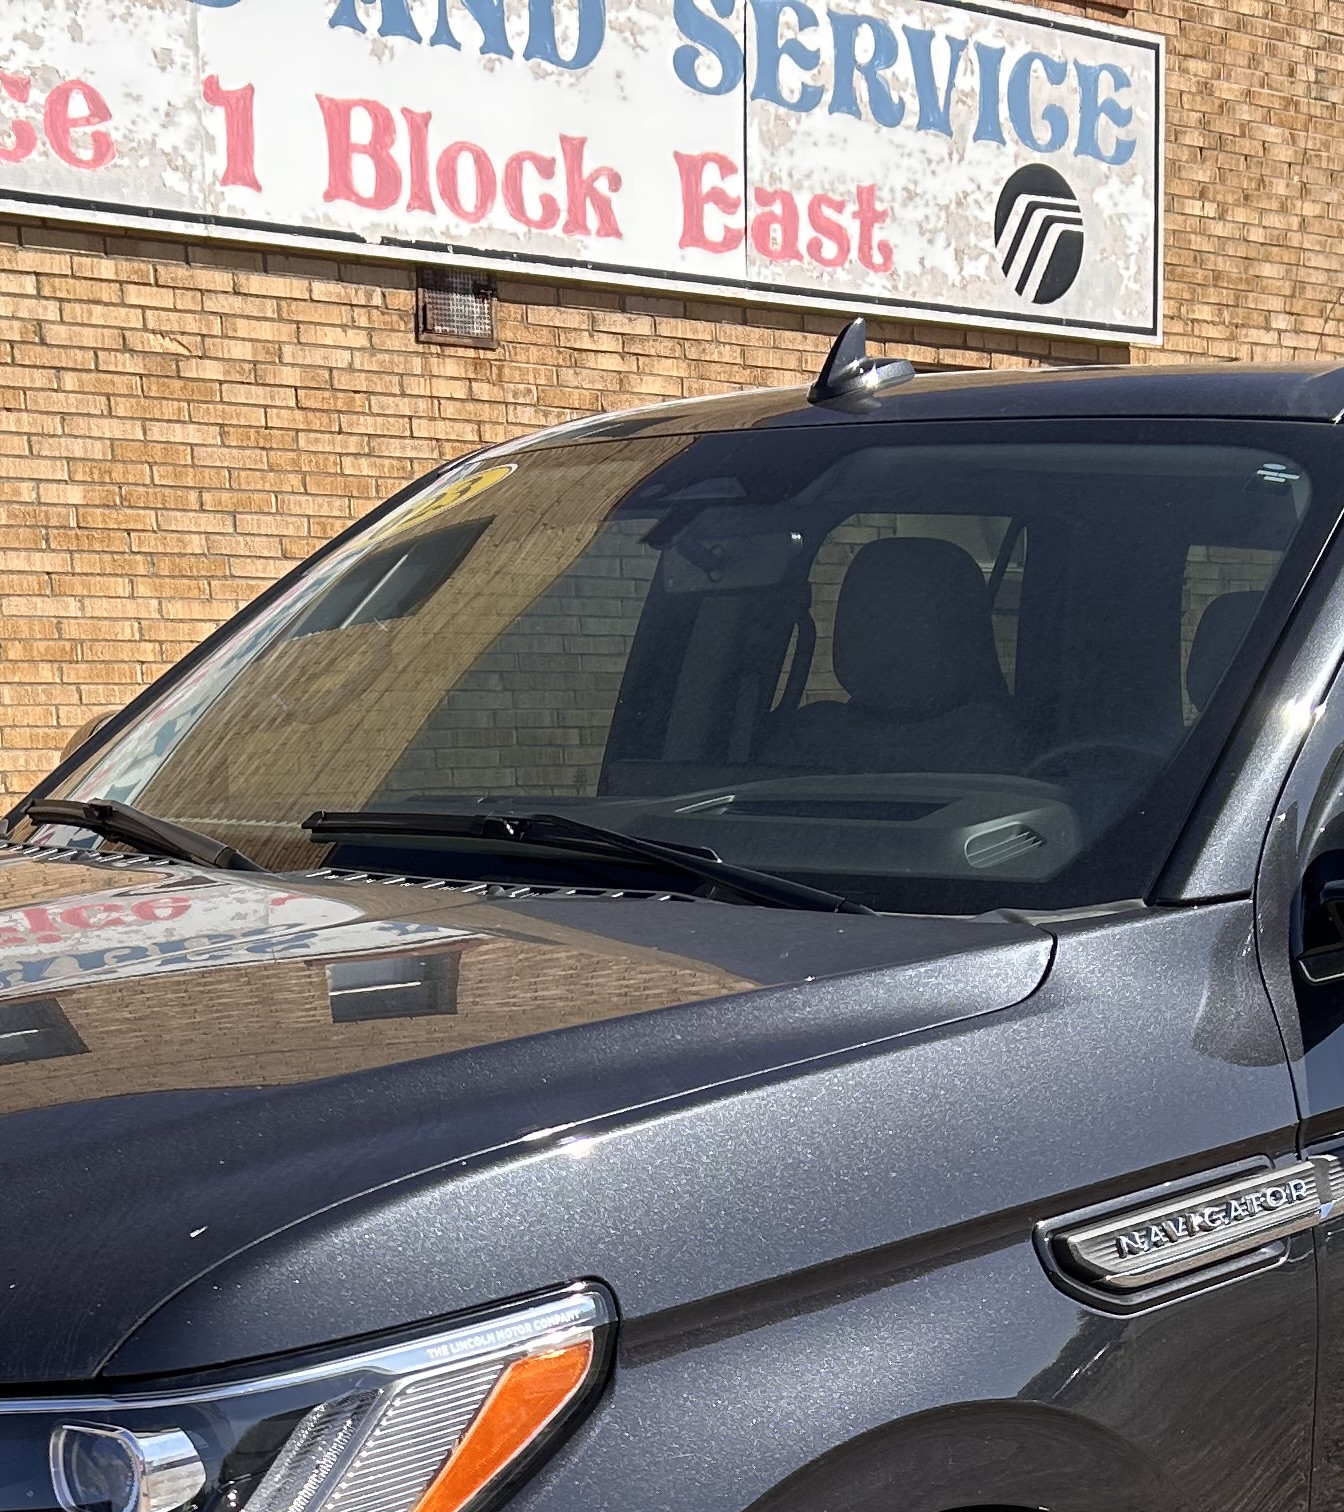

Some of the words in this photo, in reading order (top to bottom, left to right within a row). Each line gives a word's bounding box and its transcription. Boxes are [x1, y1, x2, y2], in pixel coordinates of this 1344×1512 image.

[672, 0, 1138, 166] SERVICE
[203, 74, 263, 192] 1
[315, 93, 623, 239] Block
[673, 150, 894, 273] East
[1116, 1177, 1309, 1260] NAVIGATOR
[426, 1344, 450, 1359] THE
[451, 1332, 496, 1354] LINCOLN
[496, 1321, 534, 1343] MOTOR
[534, 1308, 581, 1332] COMPANY
